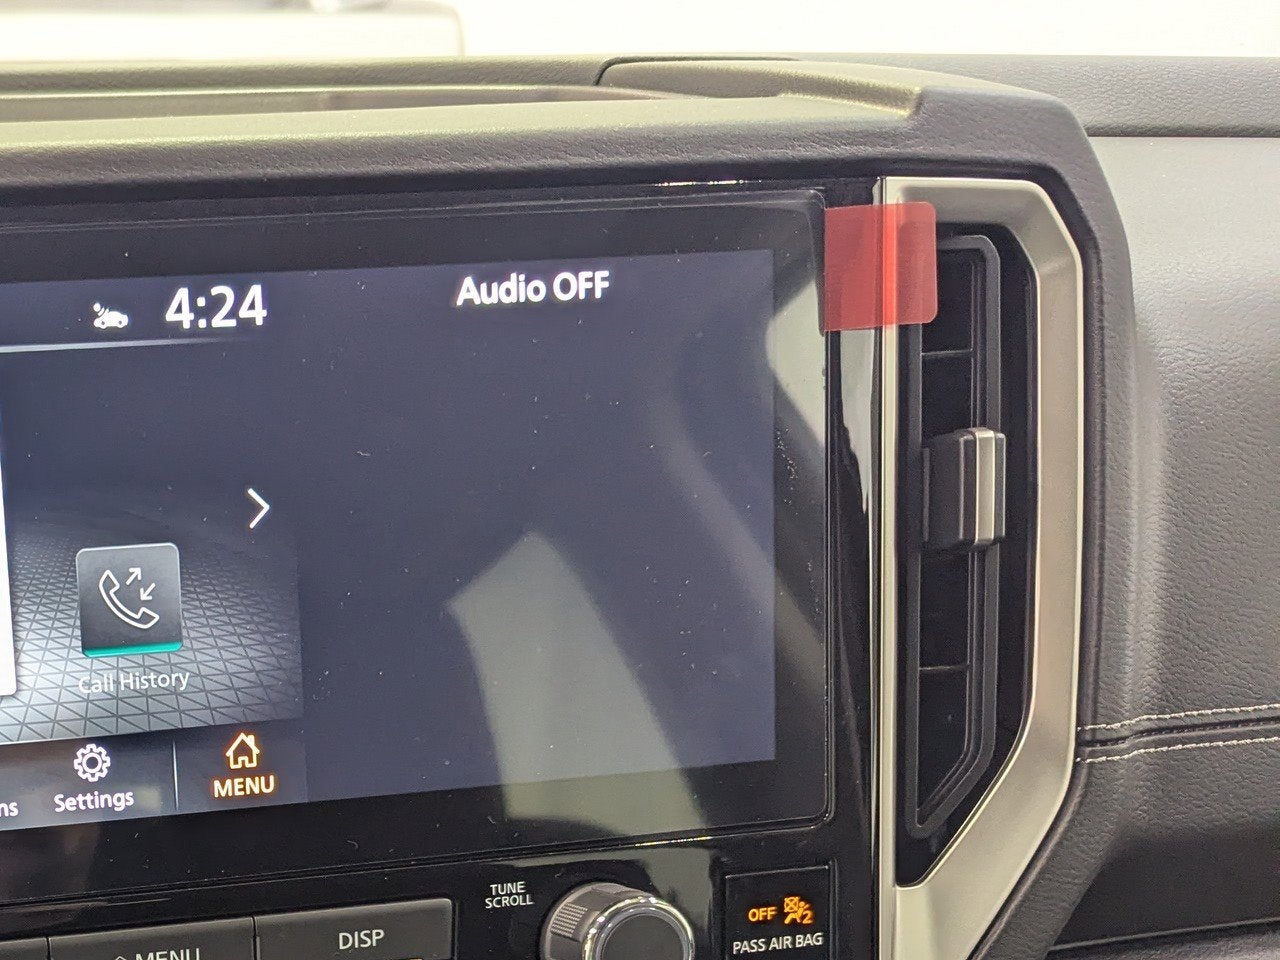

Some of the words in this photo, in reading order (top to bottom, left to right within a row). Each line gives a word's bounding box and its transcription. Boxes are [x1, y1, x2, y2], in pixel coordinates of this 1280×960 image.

[455, 272, 547, 306] Audio
[552, 270, 610, 301] OFF
[165, 283, 267, 329] 4:24
[78, 672, 117, 694] Call
[121, 670, 191, 698] History
[213, 774, 275, 798] MENU
[54, 788, 135, 813] Settings
[489, 881, 526, 896] TUNE
[484, 893, 534, 909] SCROLL
[748, 906, 778, 922] OFF
[338, 929, 385, 950] DISP
[732, 938, 766, 955] PASS
[769, 936, 793, 950] AIR
[795, 932, 823, 949] BAG
